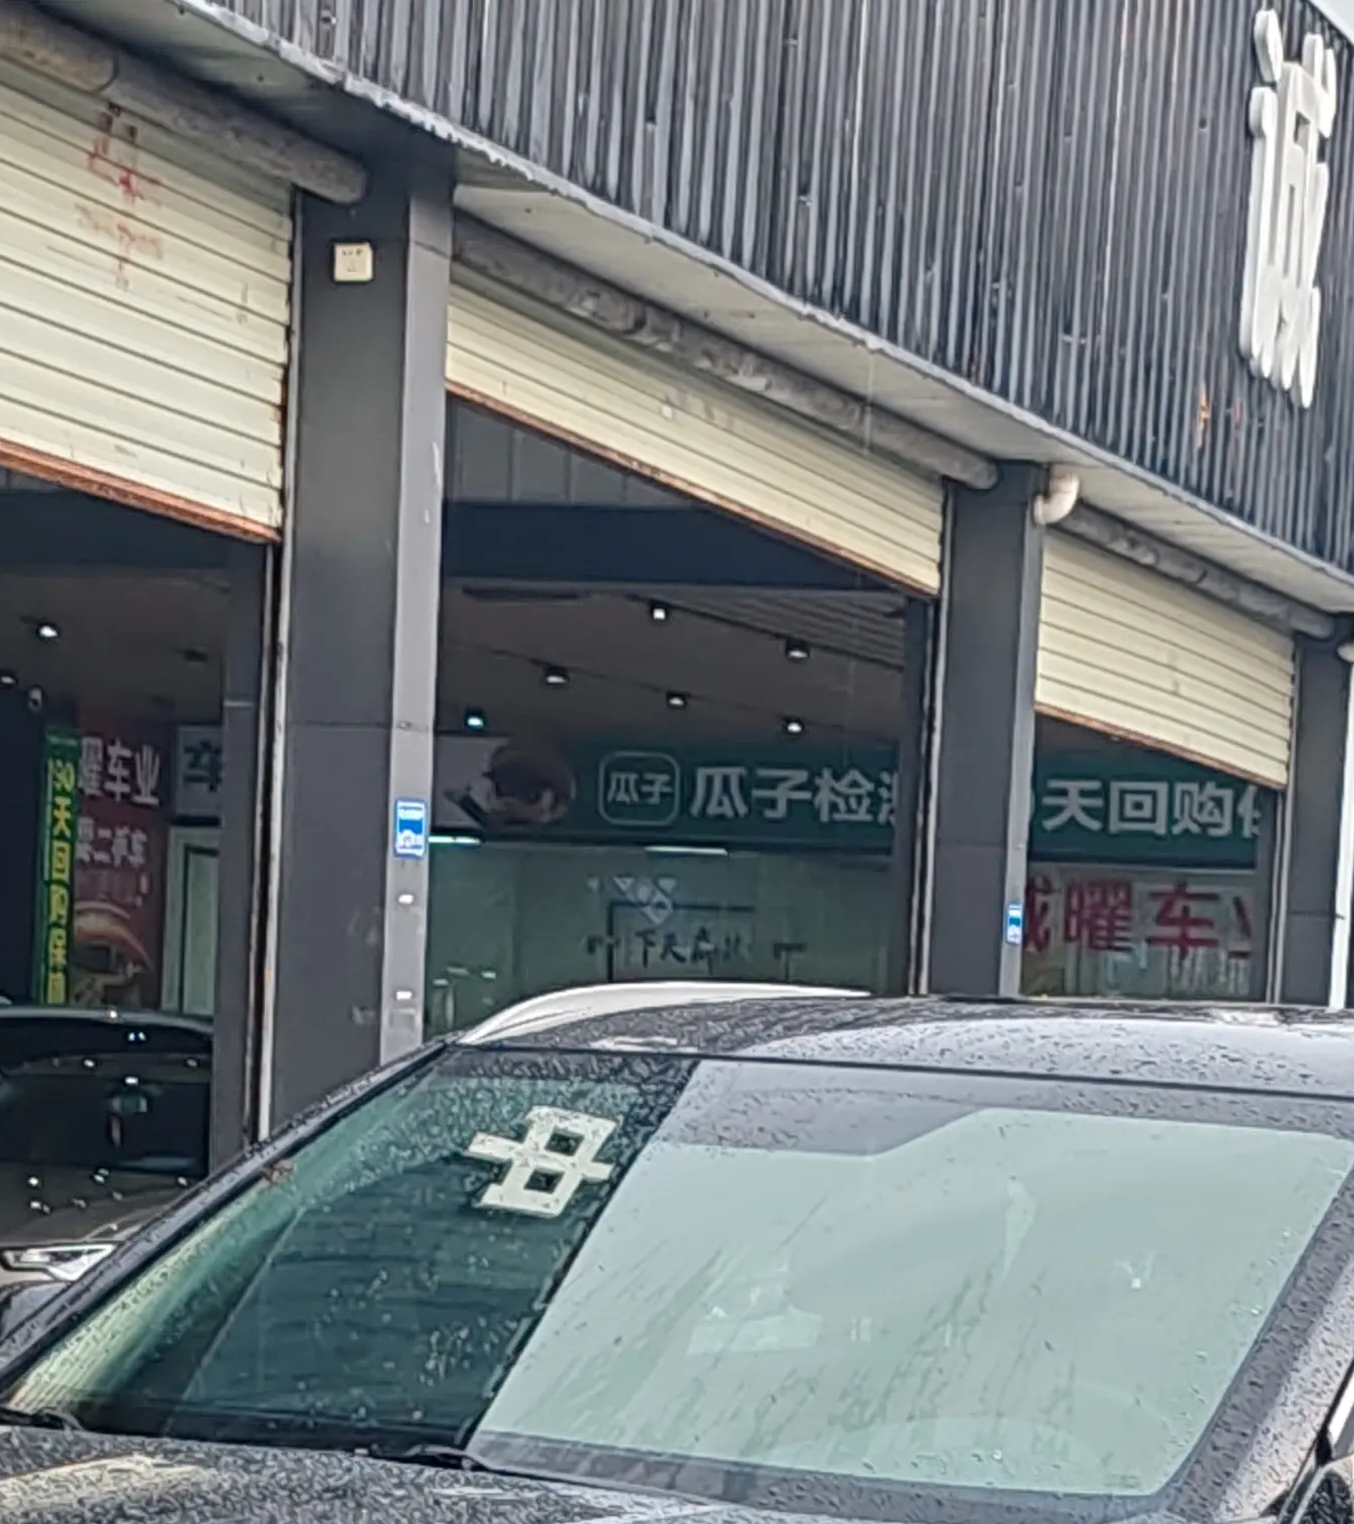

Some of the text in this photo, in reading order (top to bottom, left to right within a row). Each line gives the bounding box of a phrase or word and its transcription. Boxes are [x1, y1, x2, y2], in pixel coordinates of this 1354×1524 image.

[607, 771, 673, 805] 瓜子
[1030, 778, 1261, 838] 天回购
